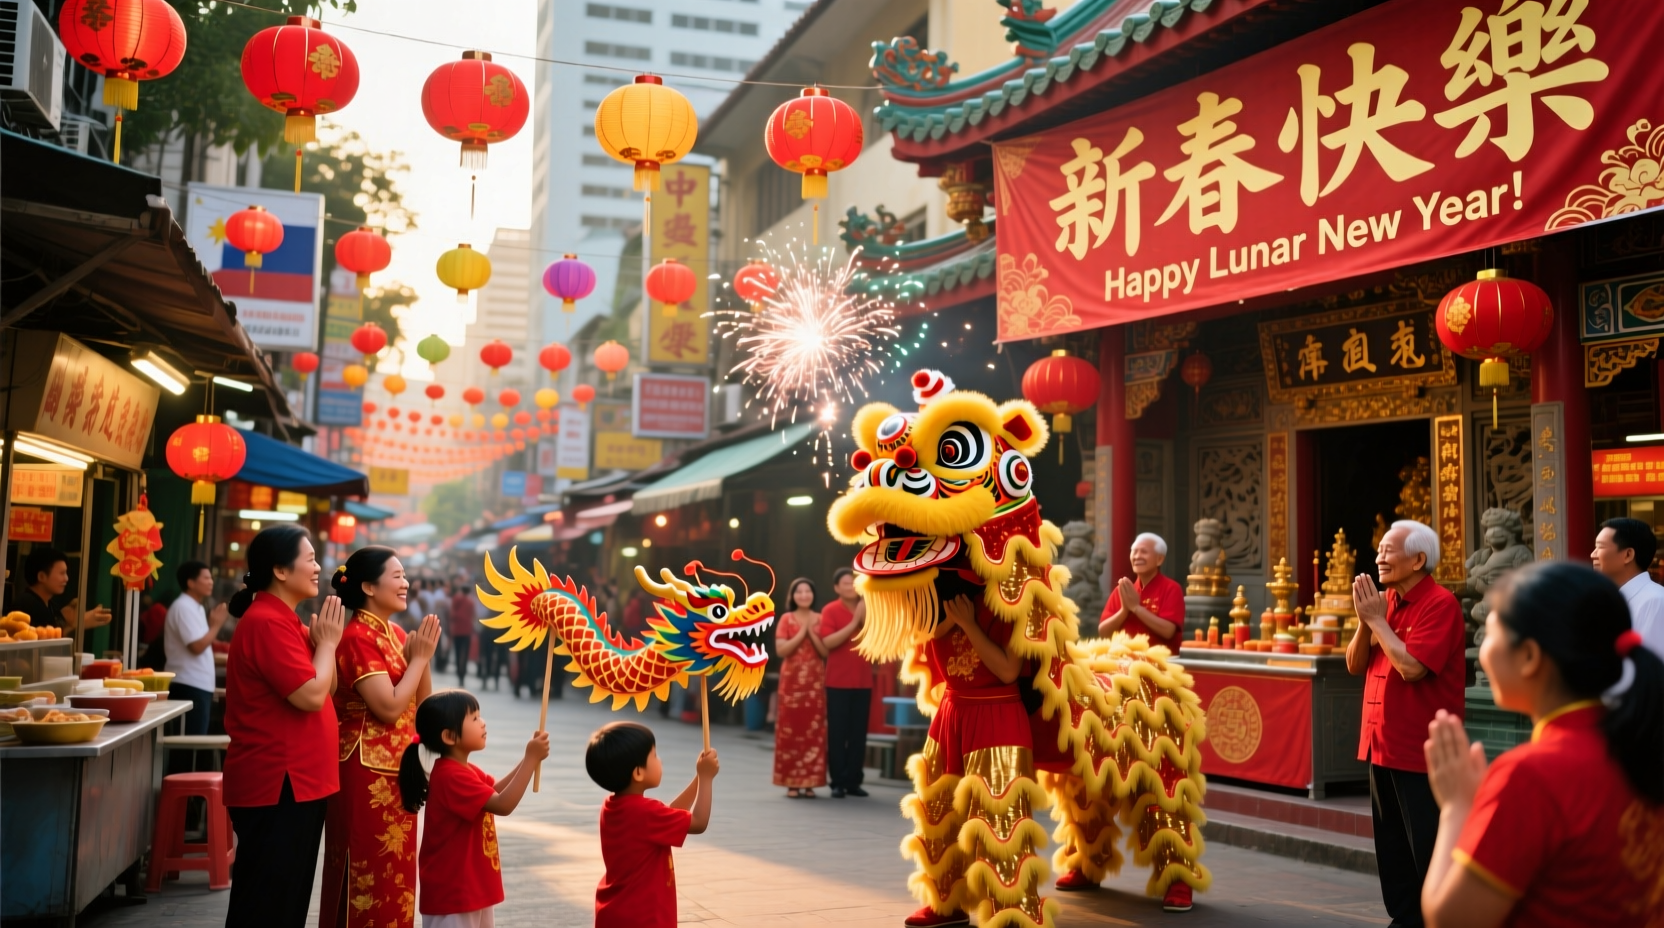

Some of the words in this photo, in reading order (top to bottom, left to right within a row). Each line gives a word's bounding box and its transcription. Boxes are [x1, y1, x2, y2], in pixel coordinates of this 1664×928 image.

[1049, 0, 1608, 261] 新春快樂
[1105, 258, 1200, 303] Happy
[1210, 232, 1307, 279] Lunar
[1318, 210, 1402, 255] New
[1413, 170, 1523, 231] Year!
